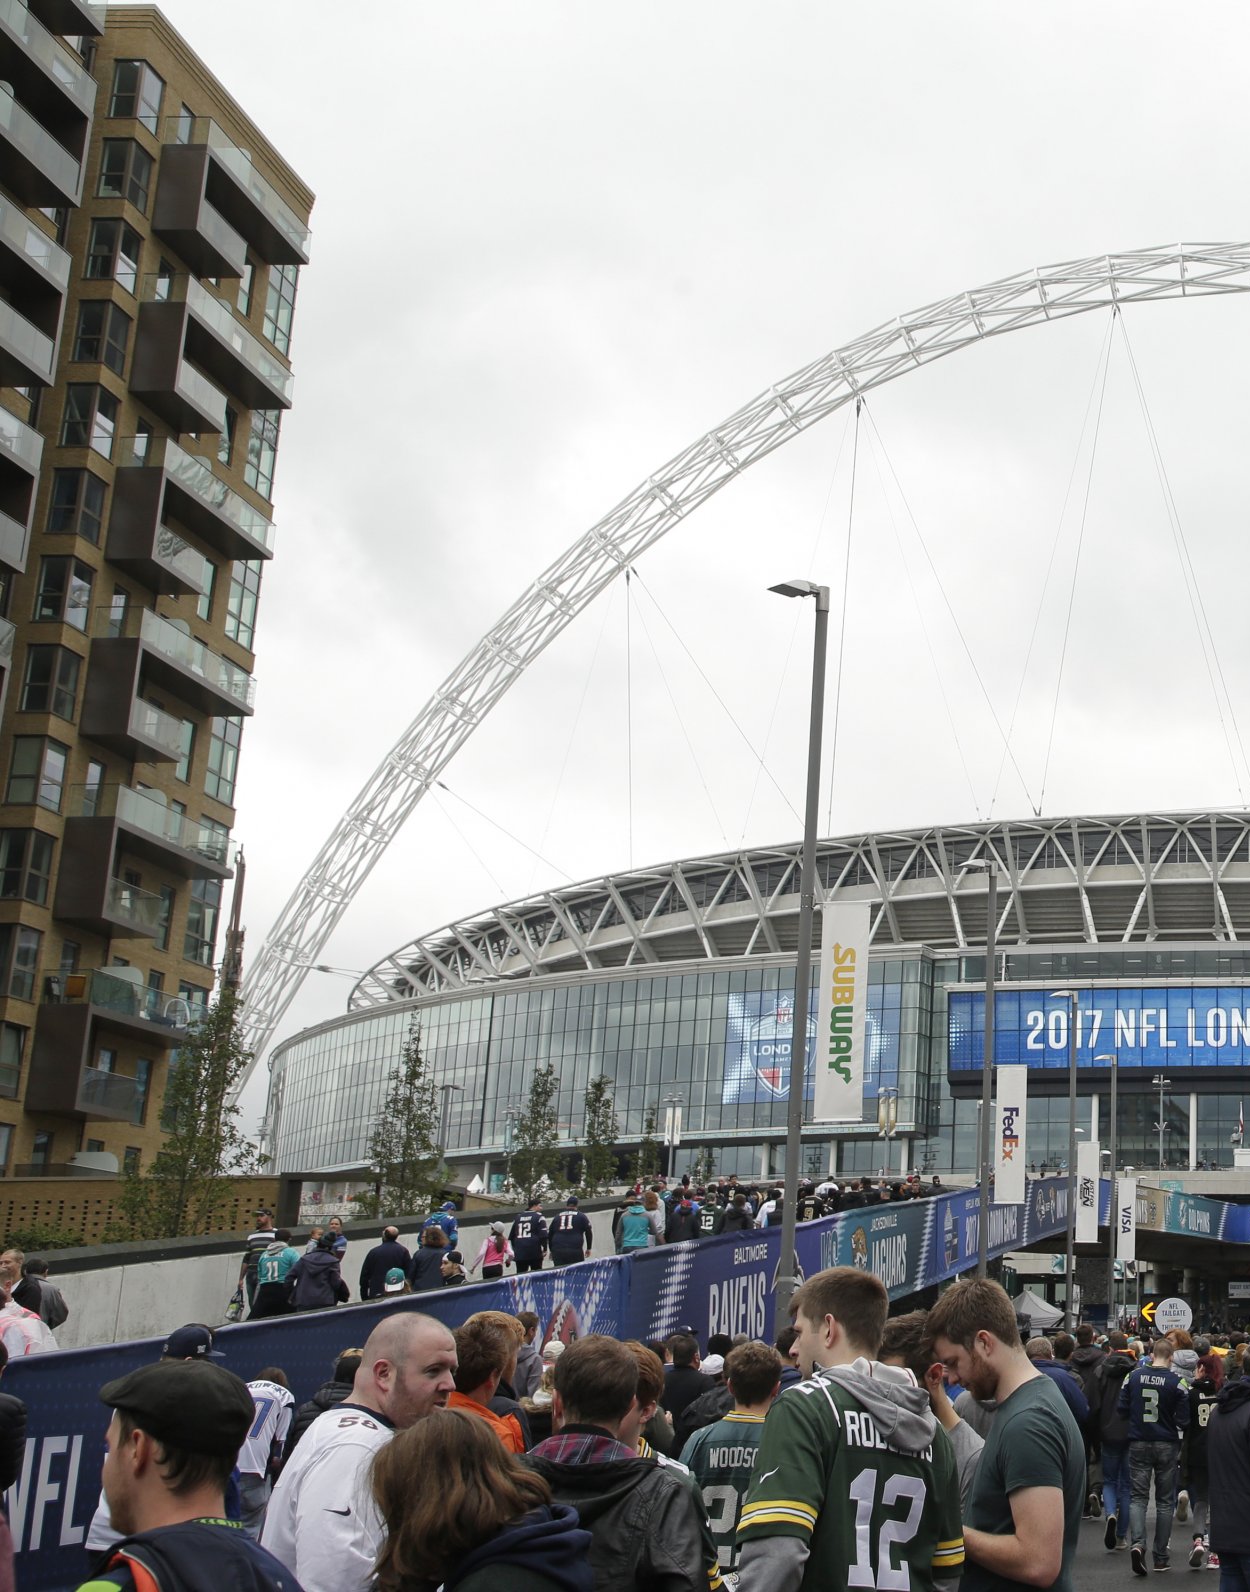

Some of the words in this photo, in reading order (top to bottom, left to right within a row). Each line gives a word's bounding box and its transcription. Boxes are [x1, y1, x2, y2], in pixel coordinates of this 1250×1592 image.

[828, 942, 856, 1085] SUBWAY
[1027, 1010, 1102, 1049] 2017
[1115, 1008, 1177, 1048] NFL
[1002, 1107, 1019, 1161] FedEx
[517, 1222, 532, 1239] 12
[559, 1215, 574, 1230] 11
[701, 1215, 714, 1230] 12
[870, 1214, 898, 1232] JACKSONVILLE
[1121, 1205, 1132, 1233] VISA
[1188, 1208, 1211, 1233] DOLPHINS
[734, 1243, 768, 1265] BALTIMORE
[871, 1233, 907, 1289] JAGUARS
[265, 1261, 279, 1281] 11
[708, 1271, 767, 1341] RAVENS
[1140, 1374, 1167, 1386] WILSON
[1142, 1388, 1159, 1423] 3
[3, 1434, 85, 1553] NFL
[848, 1468, 927, 1592] 12
